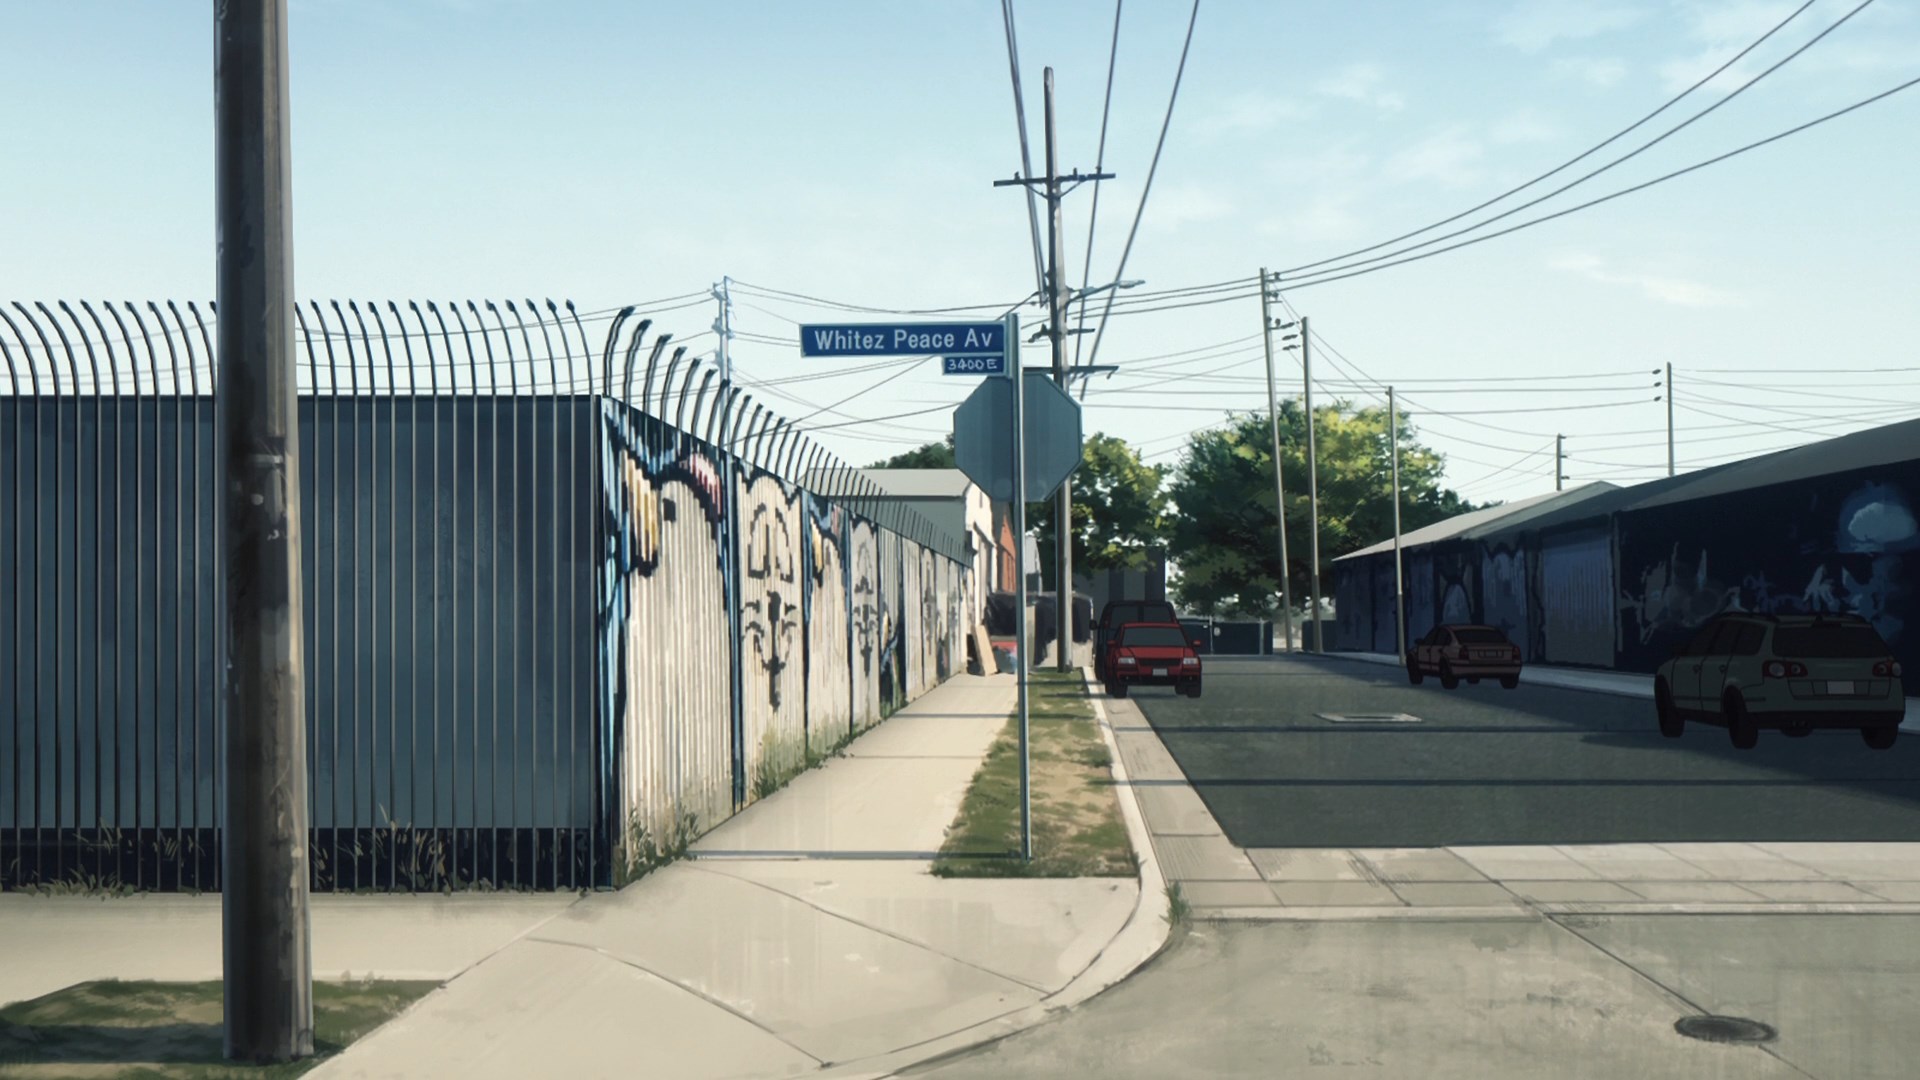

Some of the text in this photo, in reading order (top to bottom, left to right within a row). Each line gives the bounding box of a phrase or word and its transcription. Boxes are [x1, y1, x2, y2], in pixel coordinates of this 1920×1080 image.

[815, 328, 992, 350] Whitez Peace Av
